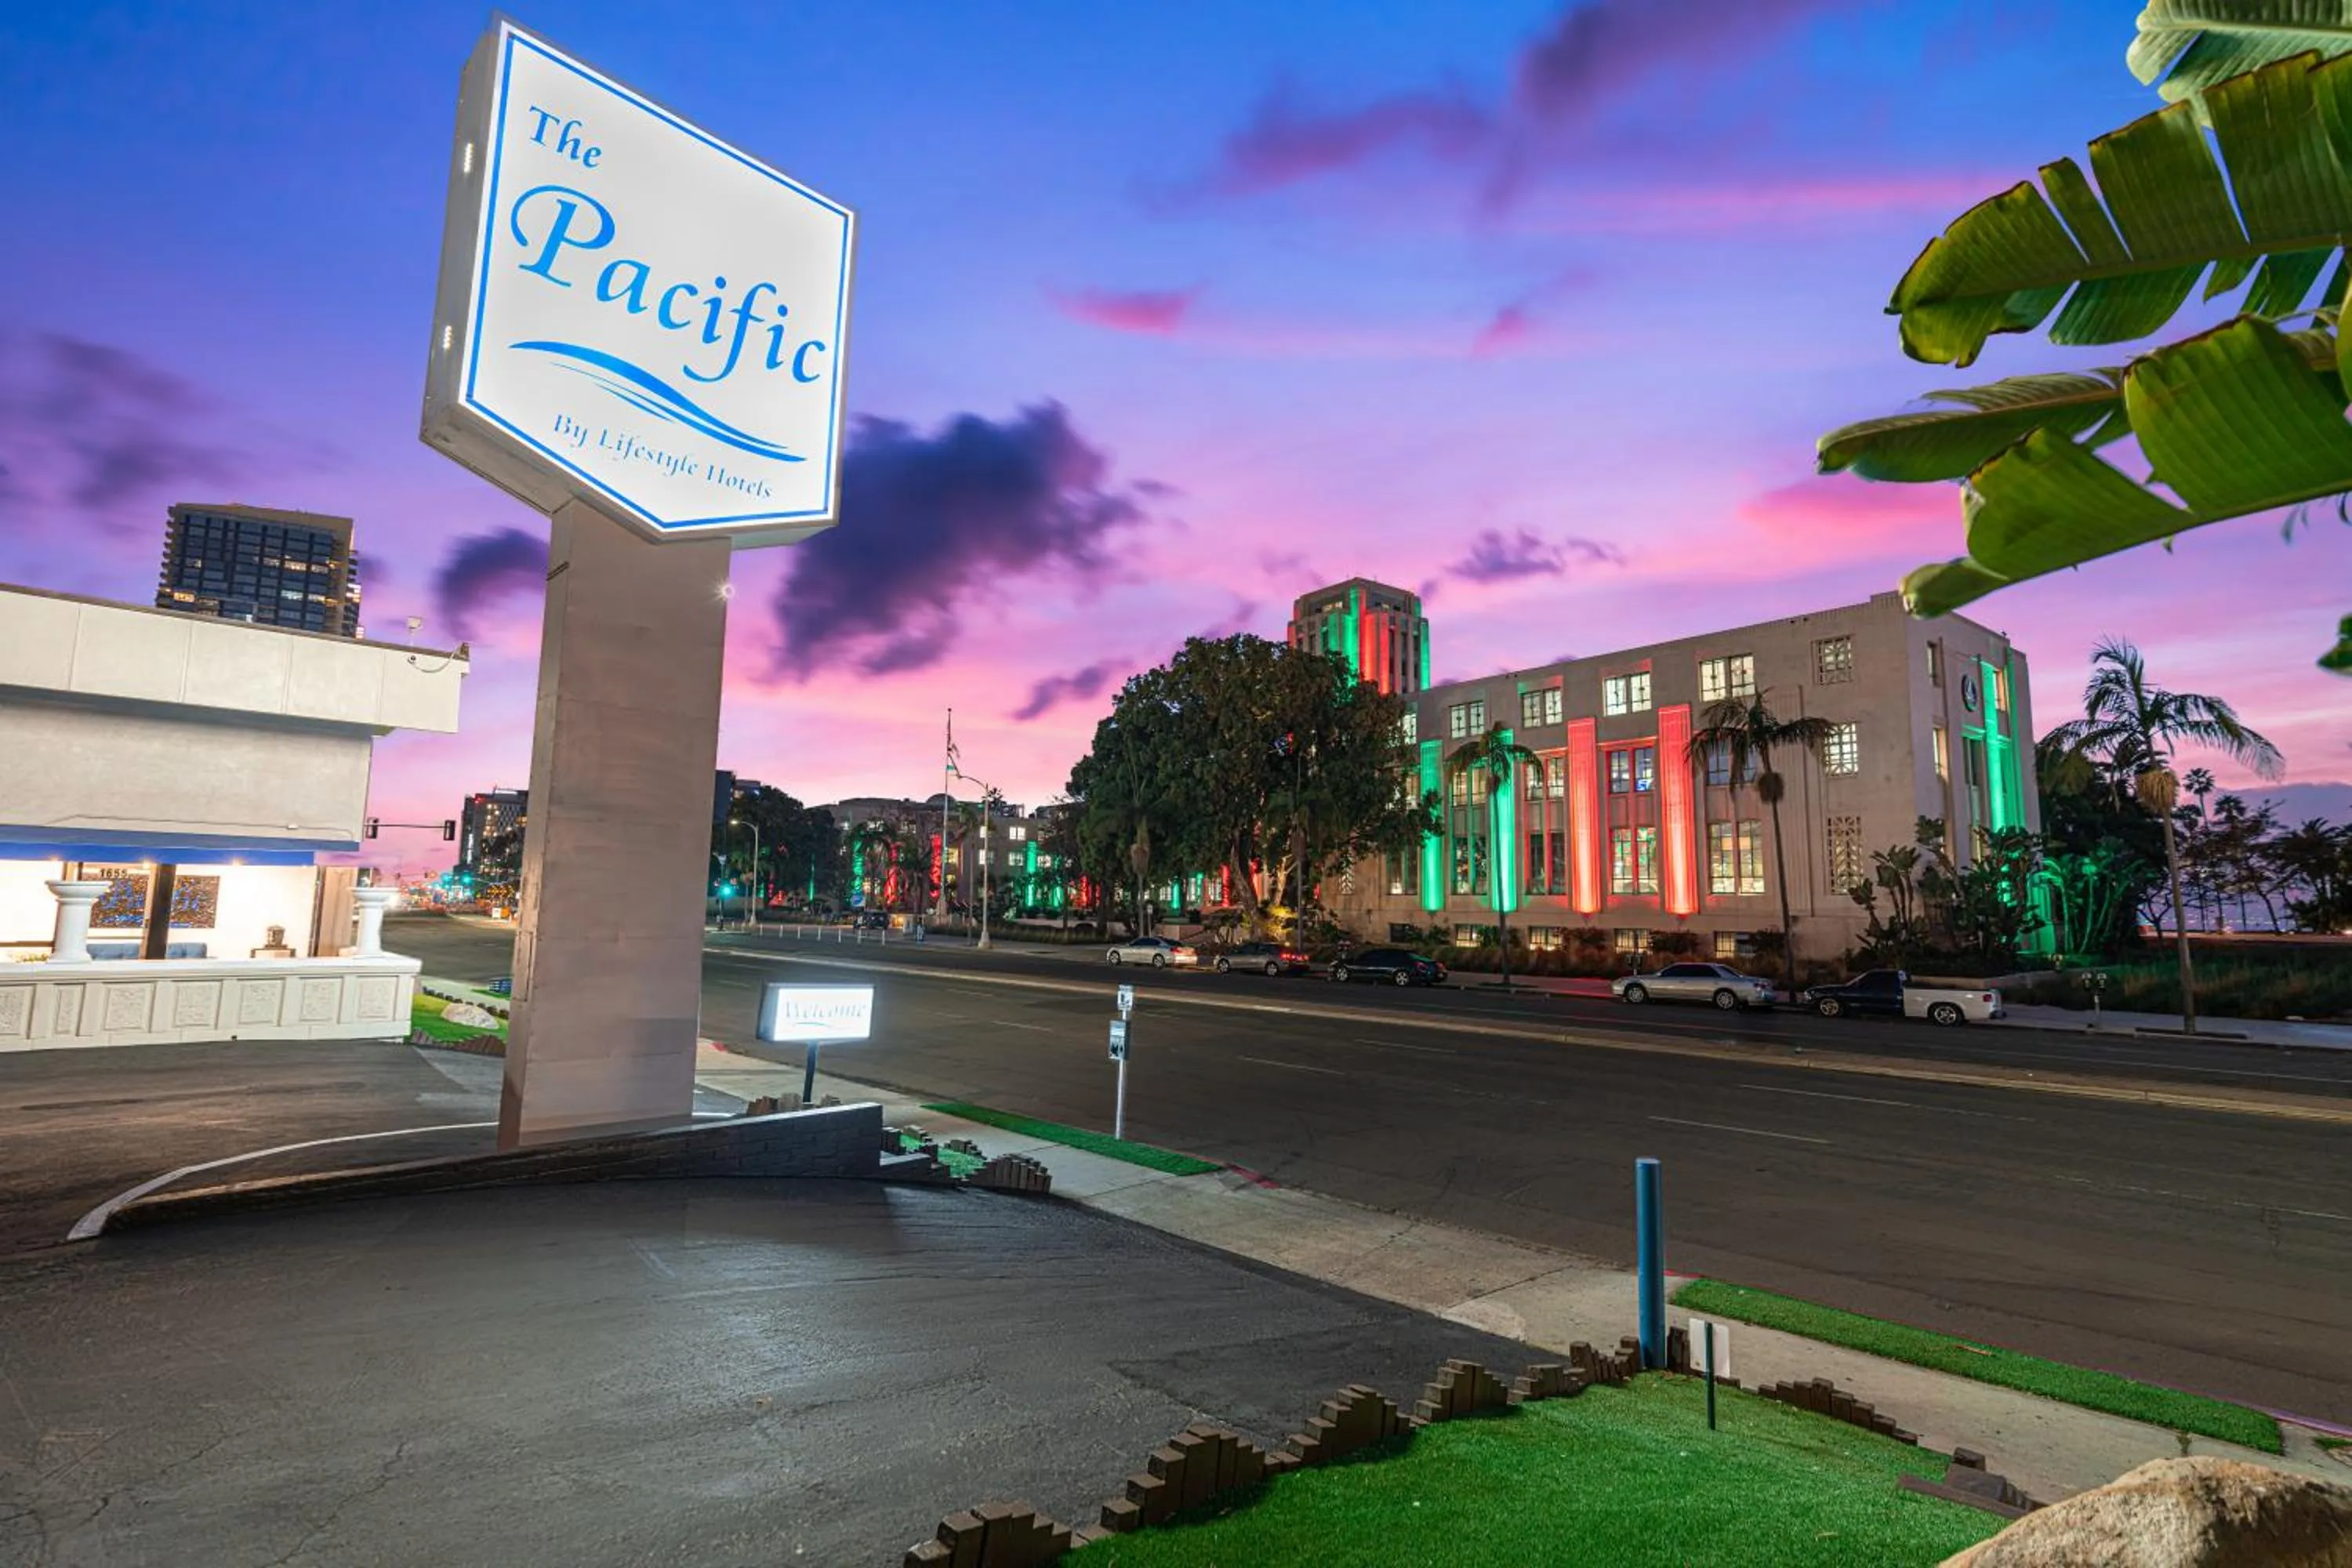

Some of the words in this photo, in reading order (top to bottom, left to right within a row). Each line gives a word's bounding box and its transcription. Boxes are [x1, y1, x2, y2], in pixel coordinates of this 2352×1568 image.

[528, 105, 602, 168] The
[510, 184, 826, 383] Pacific
[554, 414, 588, 448] By
[600, 428, 699, 477] Lifestyle
[706, 464, 774, 499] Hotels
[100, 868, 128, 877] 1655
[786, 1001, 866, 1018] Welcome
